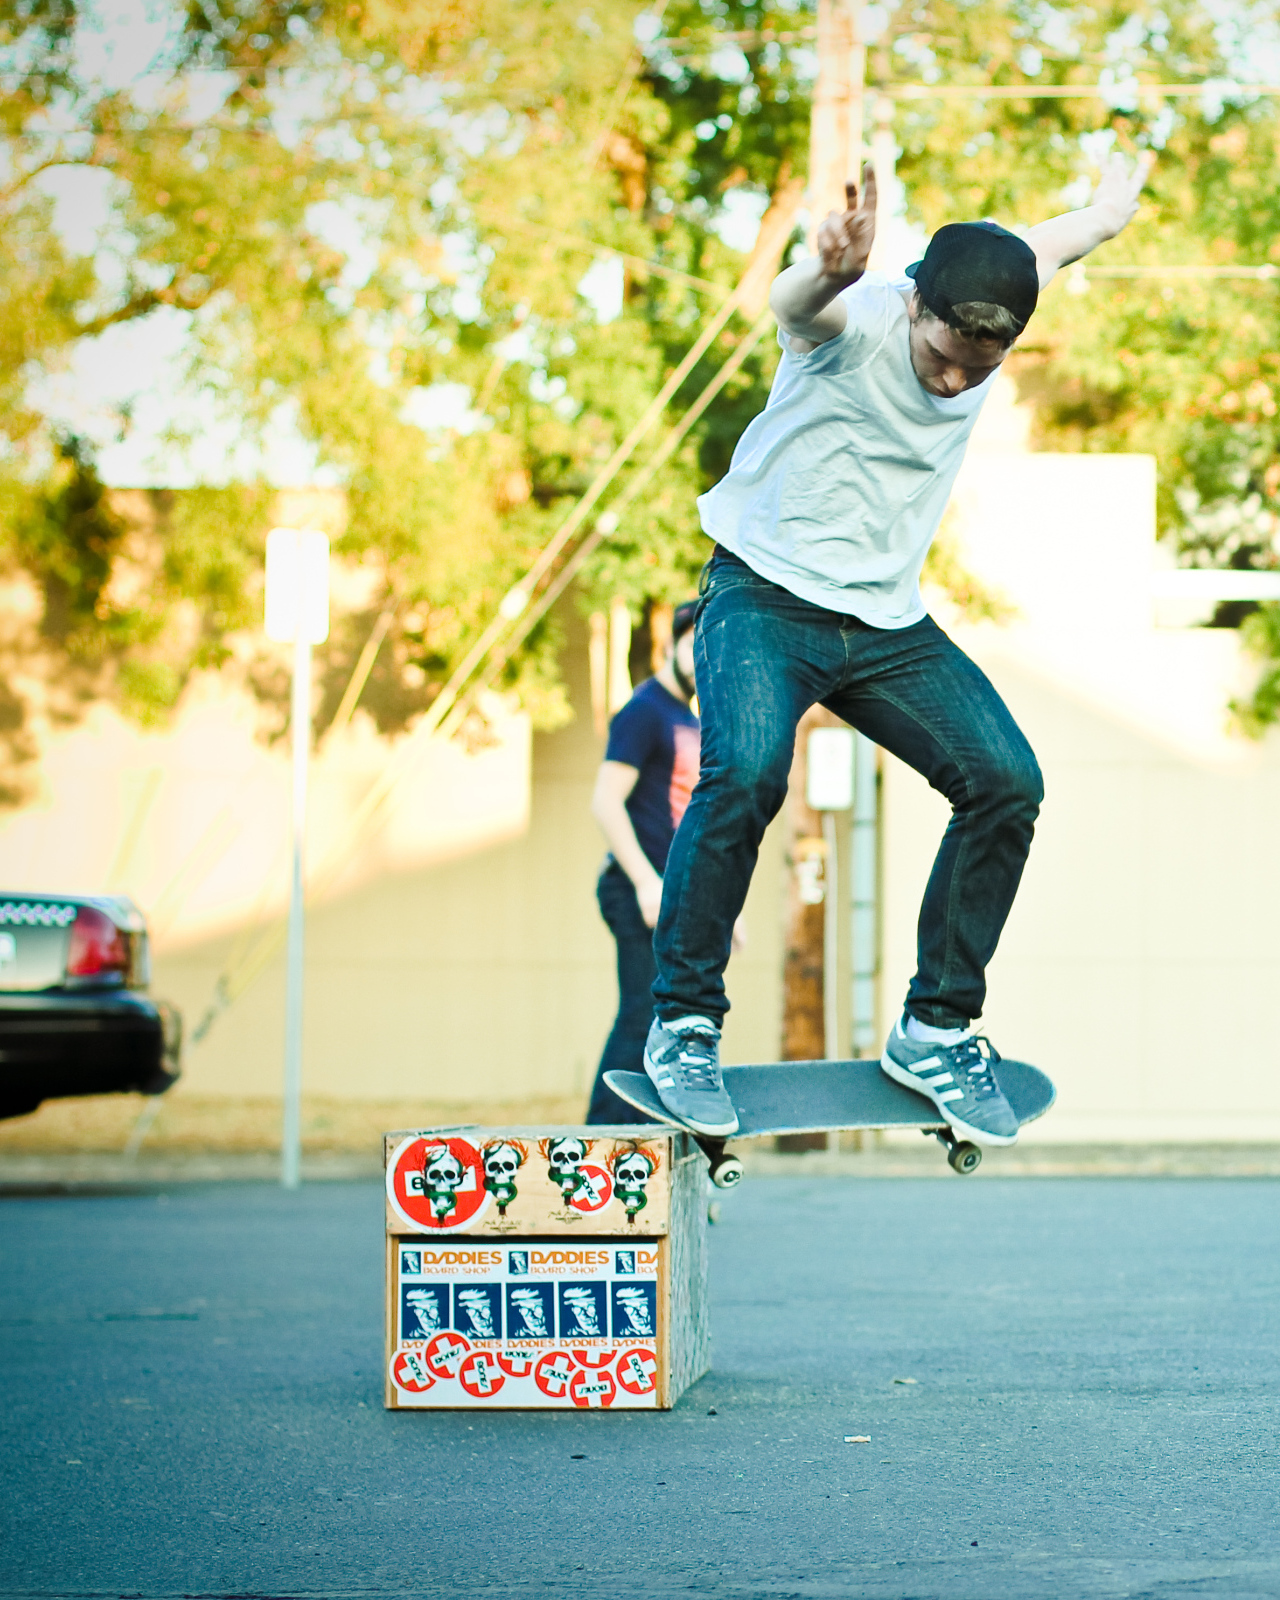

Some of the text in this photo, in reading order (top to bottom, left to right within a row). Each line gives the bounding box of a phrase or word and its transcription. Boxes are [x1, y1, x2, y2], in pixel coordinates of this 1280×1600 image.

[423, 1251, 502, 1265] DADDIES
[530, 1251, 610, 1265] DADDIES
[423, 1266, 490, 1274] BOARD SHOP
[530, 1266, 598, 1274] BOARD SHOP
[637, 1266, 658, 1274] BOA
[473, 1340, 502, 1348] DIES
[507, 1339, 555, 1348] DADDIES
[560, 1339, 608, 1348] DADDIES
[435, 1347, 460, 1364] BONES
[408, 1356, 426, 1382] BONES
[477, 1361, 488, 1389] BONES
[543, 1368, 569, 1382] ONES
[631, 1358, 648, 1384] BONES
